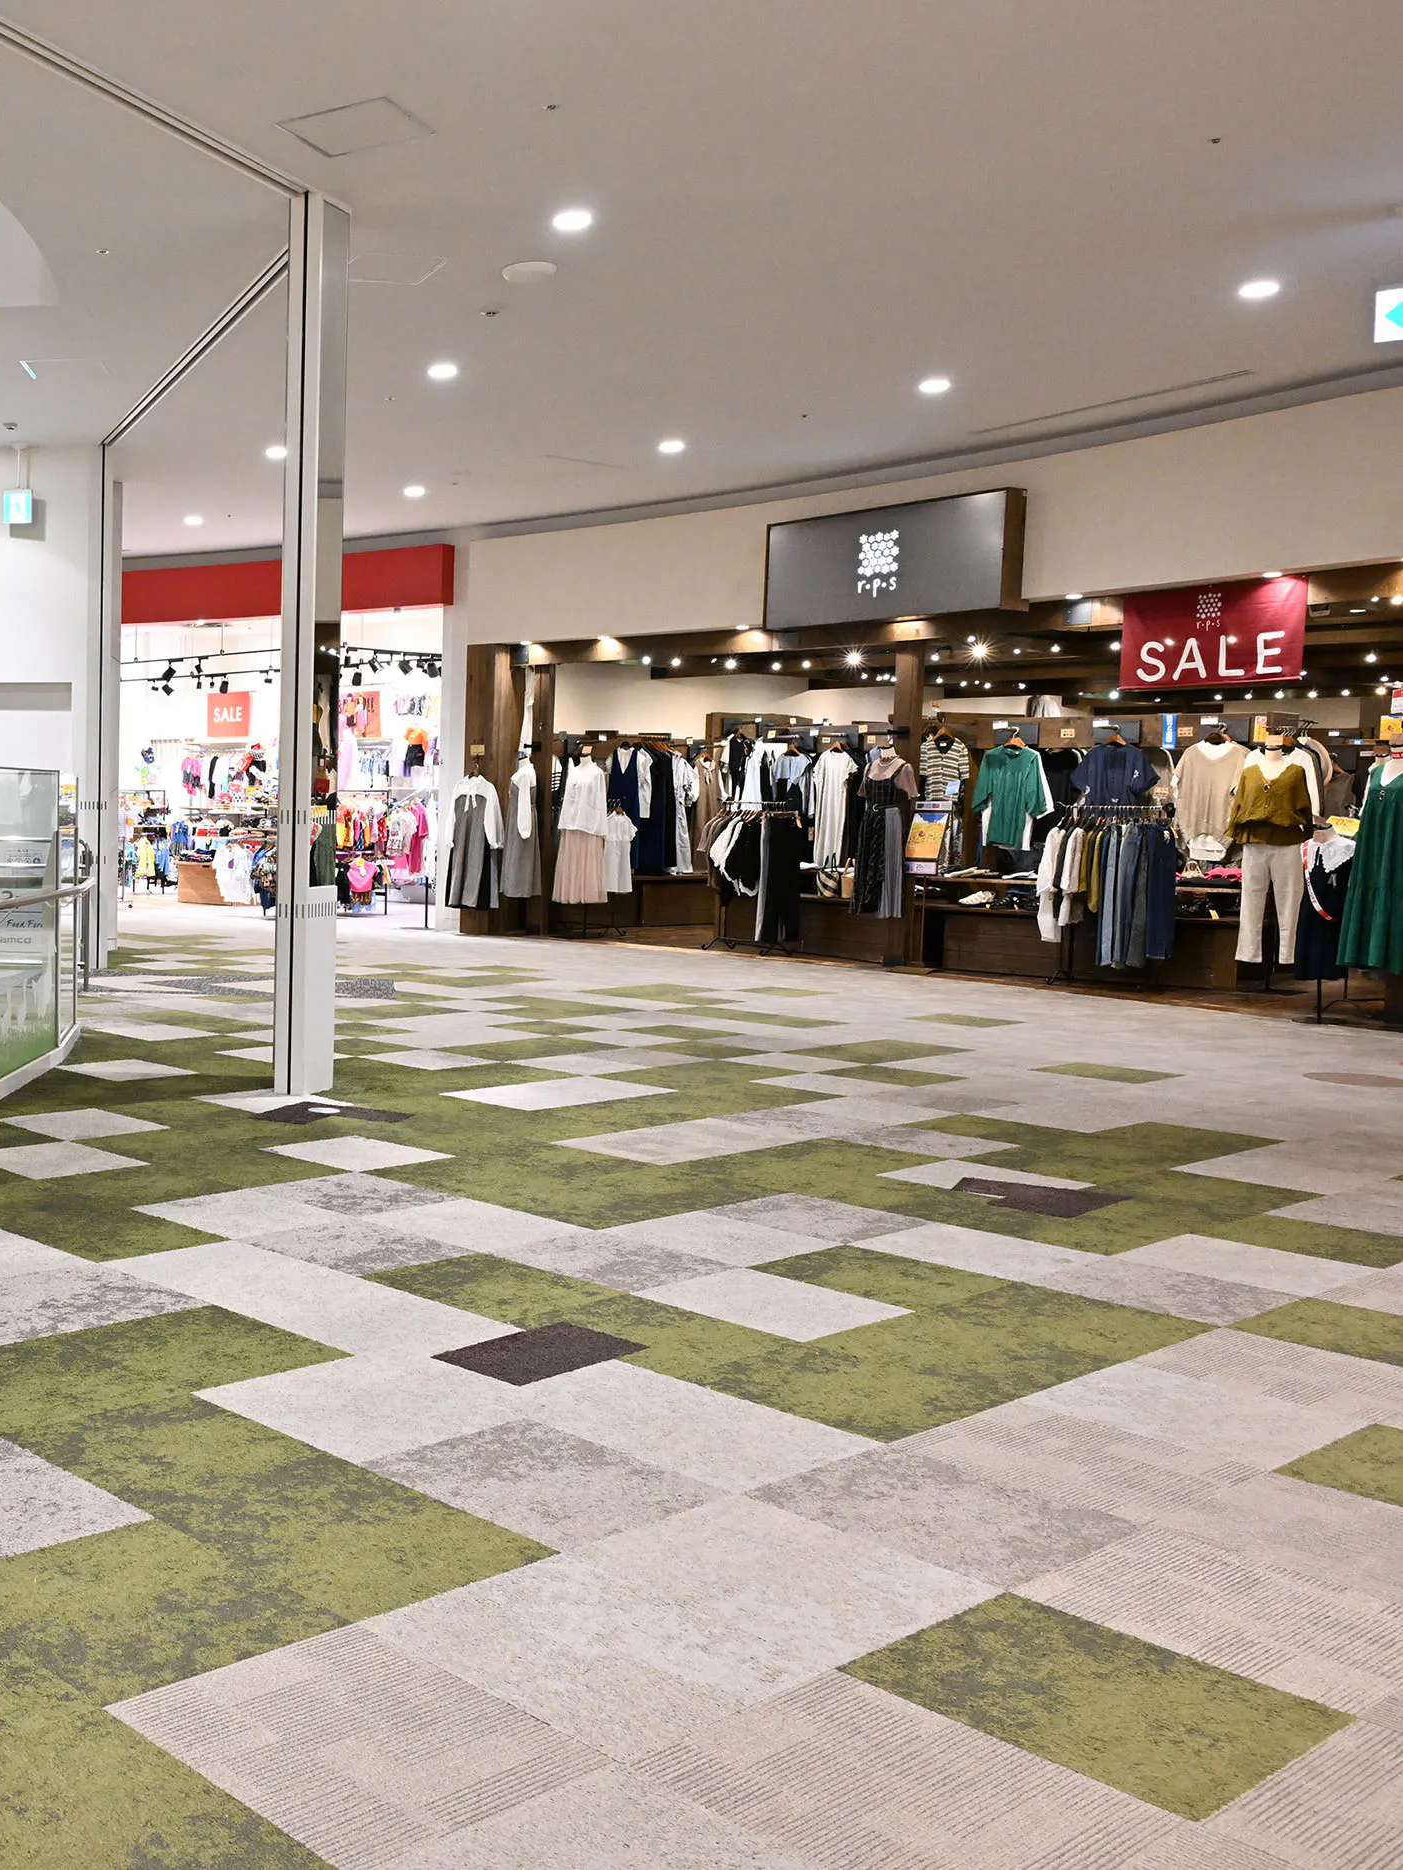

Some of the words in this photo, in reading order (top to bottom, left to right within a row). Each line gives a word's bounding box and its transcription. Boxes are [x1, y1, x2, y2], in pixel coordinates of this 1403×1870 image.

[1136, 630, 1286, 682] SALE
[212, 706, 243, 723] SALE
[6, 919, 25, 929] Food
